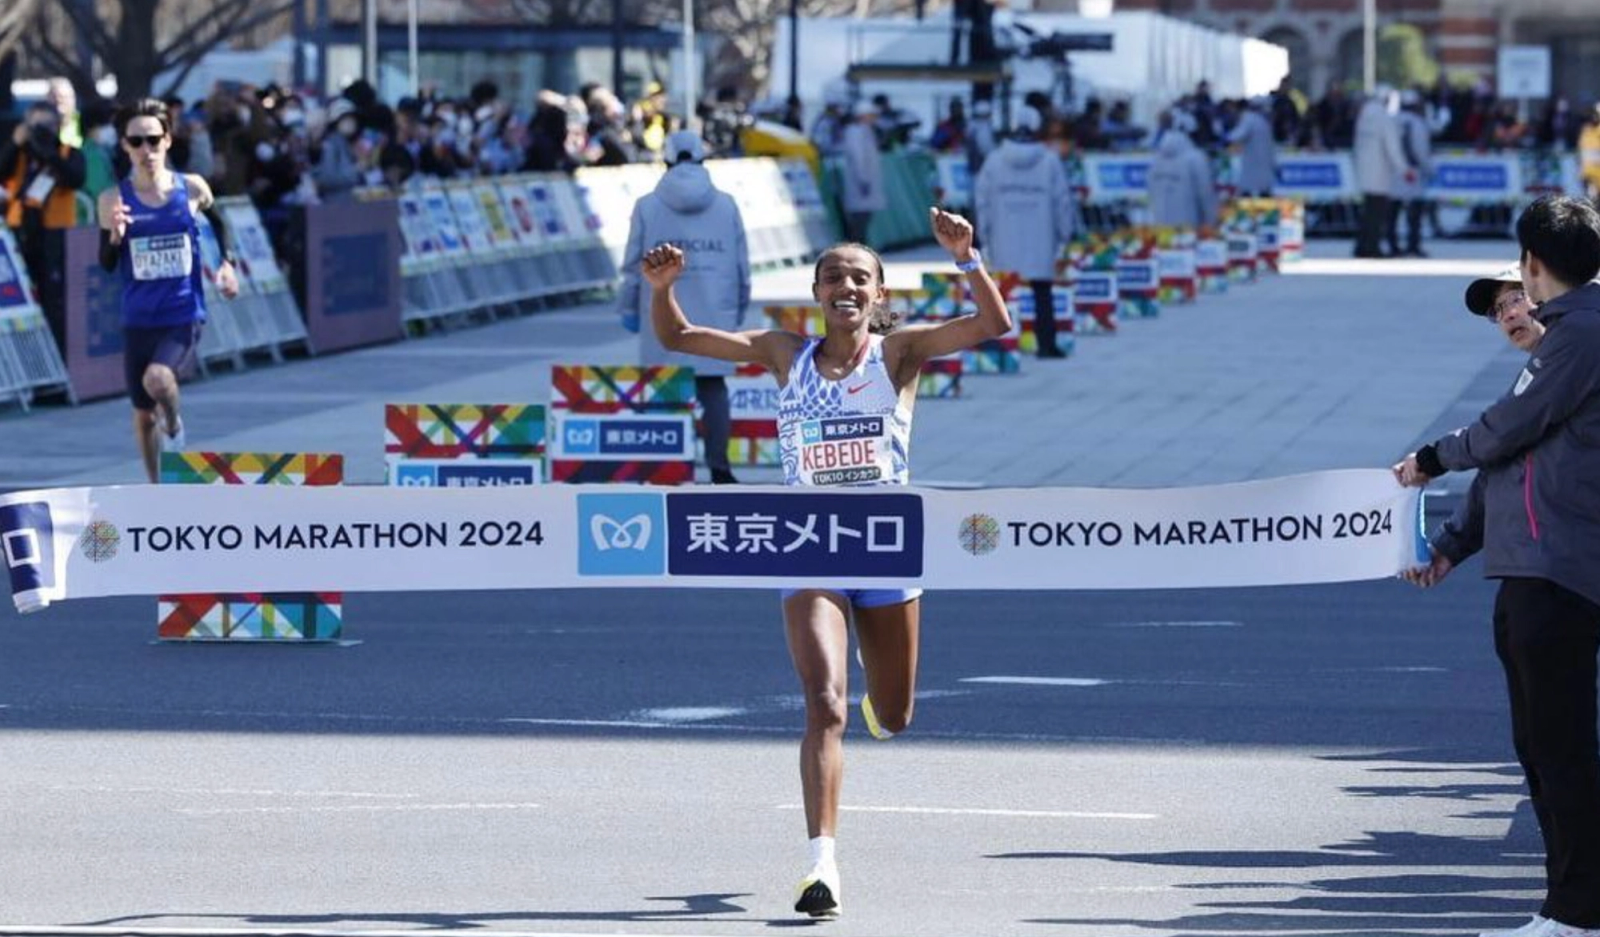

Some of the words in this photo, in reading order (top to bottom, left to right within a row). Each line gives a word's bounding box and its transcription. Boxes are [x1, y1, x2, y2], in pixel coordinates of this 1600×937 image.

[824, 421, 880, 436] 東京メトロ
[802, 440, 876, 471] KEBEDE
[127, 525, 243, 552] TOKYO
[254, 521, 448, 550] MARATHON
[458, 520, 545, 547] 2024
[685, 512, 905, 554] 東京メトロ
[1007, 521, 1122, 547] TOKYO
[1134, 513, 1323, 546] MARATHON
[1332, 508, 1393, 539] 2024
